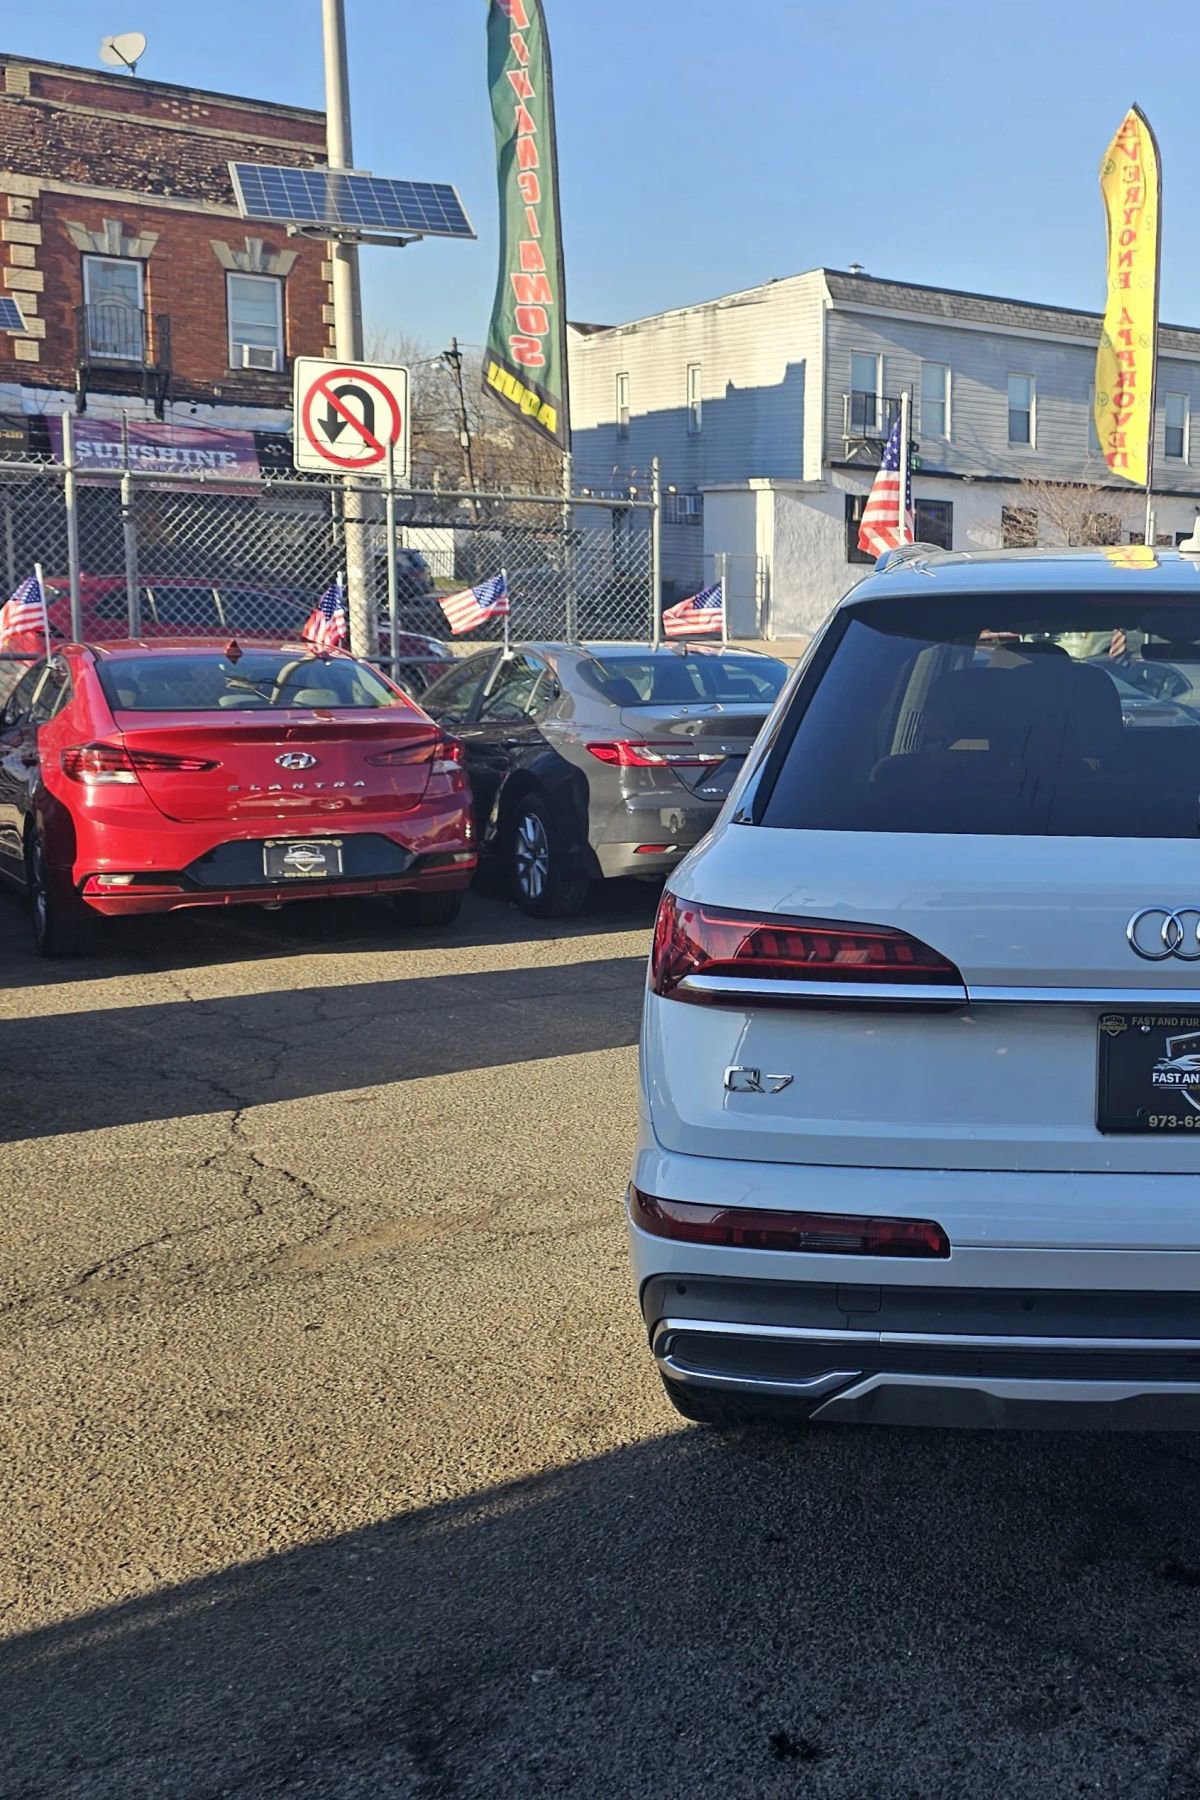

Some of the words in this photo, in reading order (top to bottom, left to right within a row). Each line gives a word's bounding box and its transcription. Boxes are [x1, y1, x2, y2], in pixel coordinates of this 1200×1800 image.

[75, 440, 239, 469] SUNSHINE
[227, 780, 366, 792] ELANTRA
[1132, 1016, 1156, 1026] FAST
[1157, 1017, 1178, 1026] AND
[723, 1065, 794, 1094] Q7
[1152, 1072, 1181, 1084] FAST
